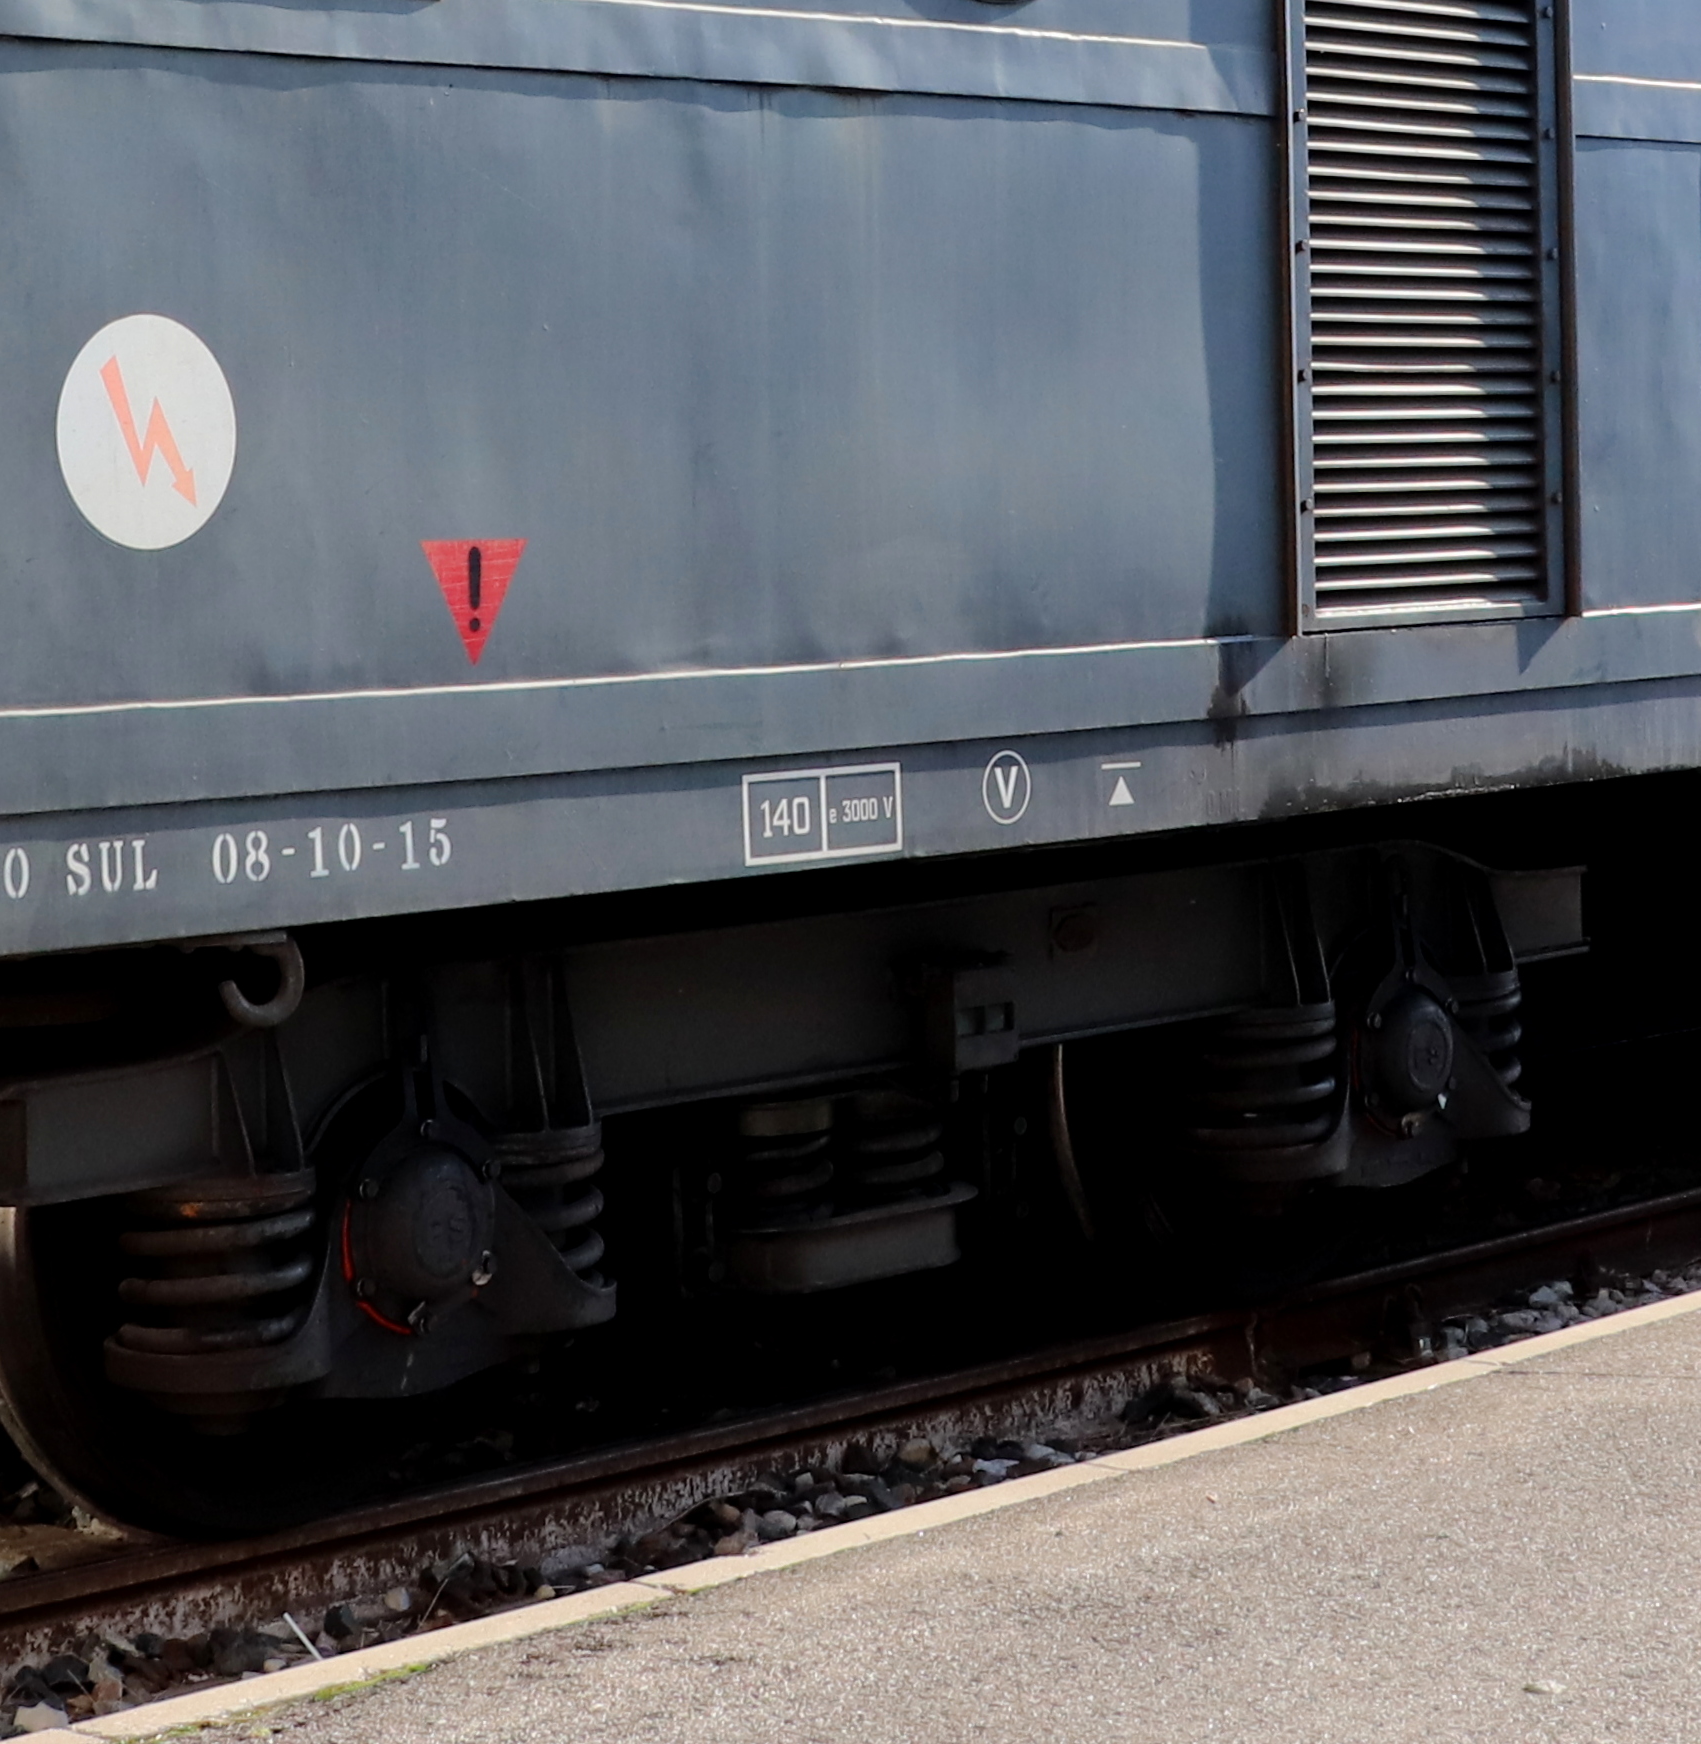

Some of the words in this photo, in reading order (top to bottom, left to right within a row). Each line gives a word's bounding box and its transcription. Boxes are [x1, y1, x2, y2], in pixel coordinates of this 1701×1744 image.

[995, 765, 1018, 809] V
[760, 796, 811, 838] 140
[842, 797, 876, 823] 3000
[883, 796, 893, 820] V
[66, 840, 158, 897] SUL
[211, 818, 454, 885] 08-10-15
